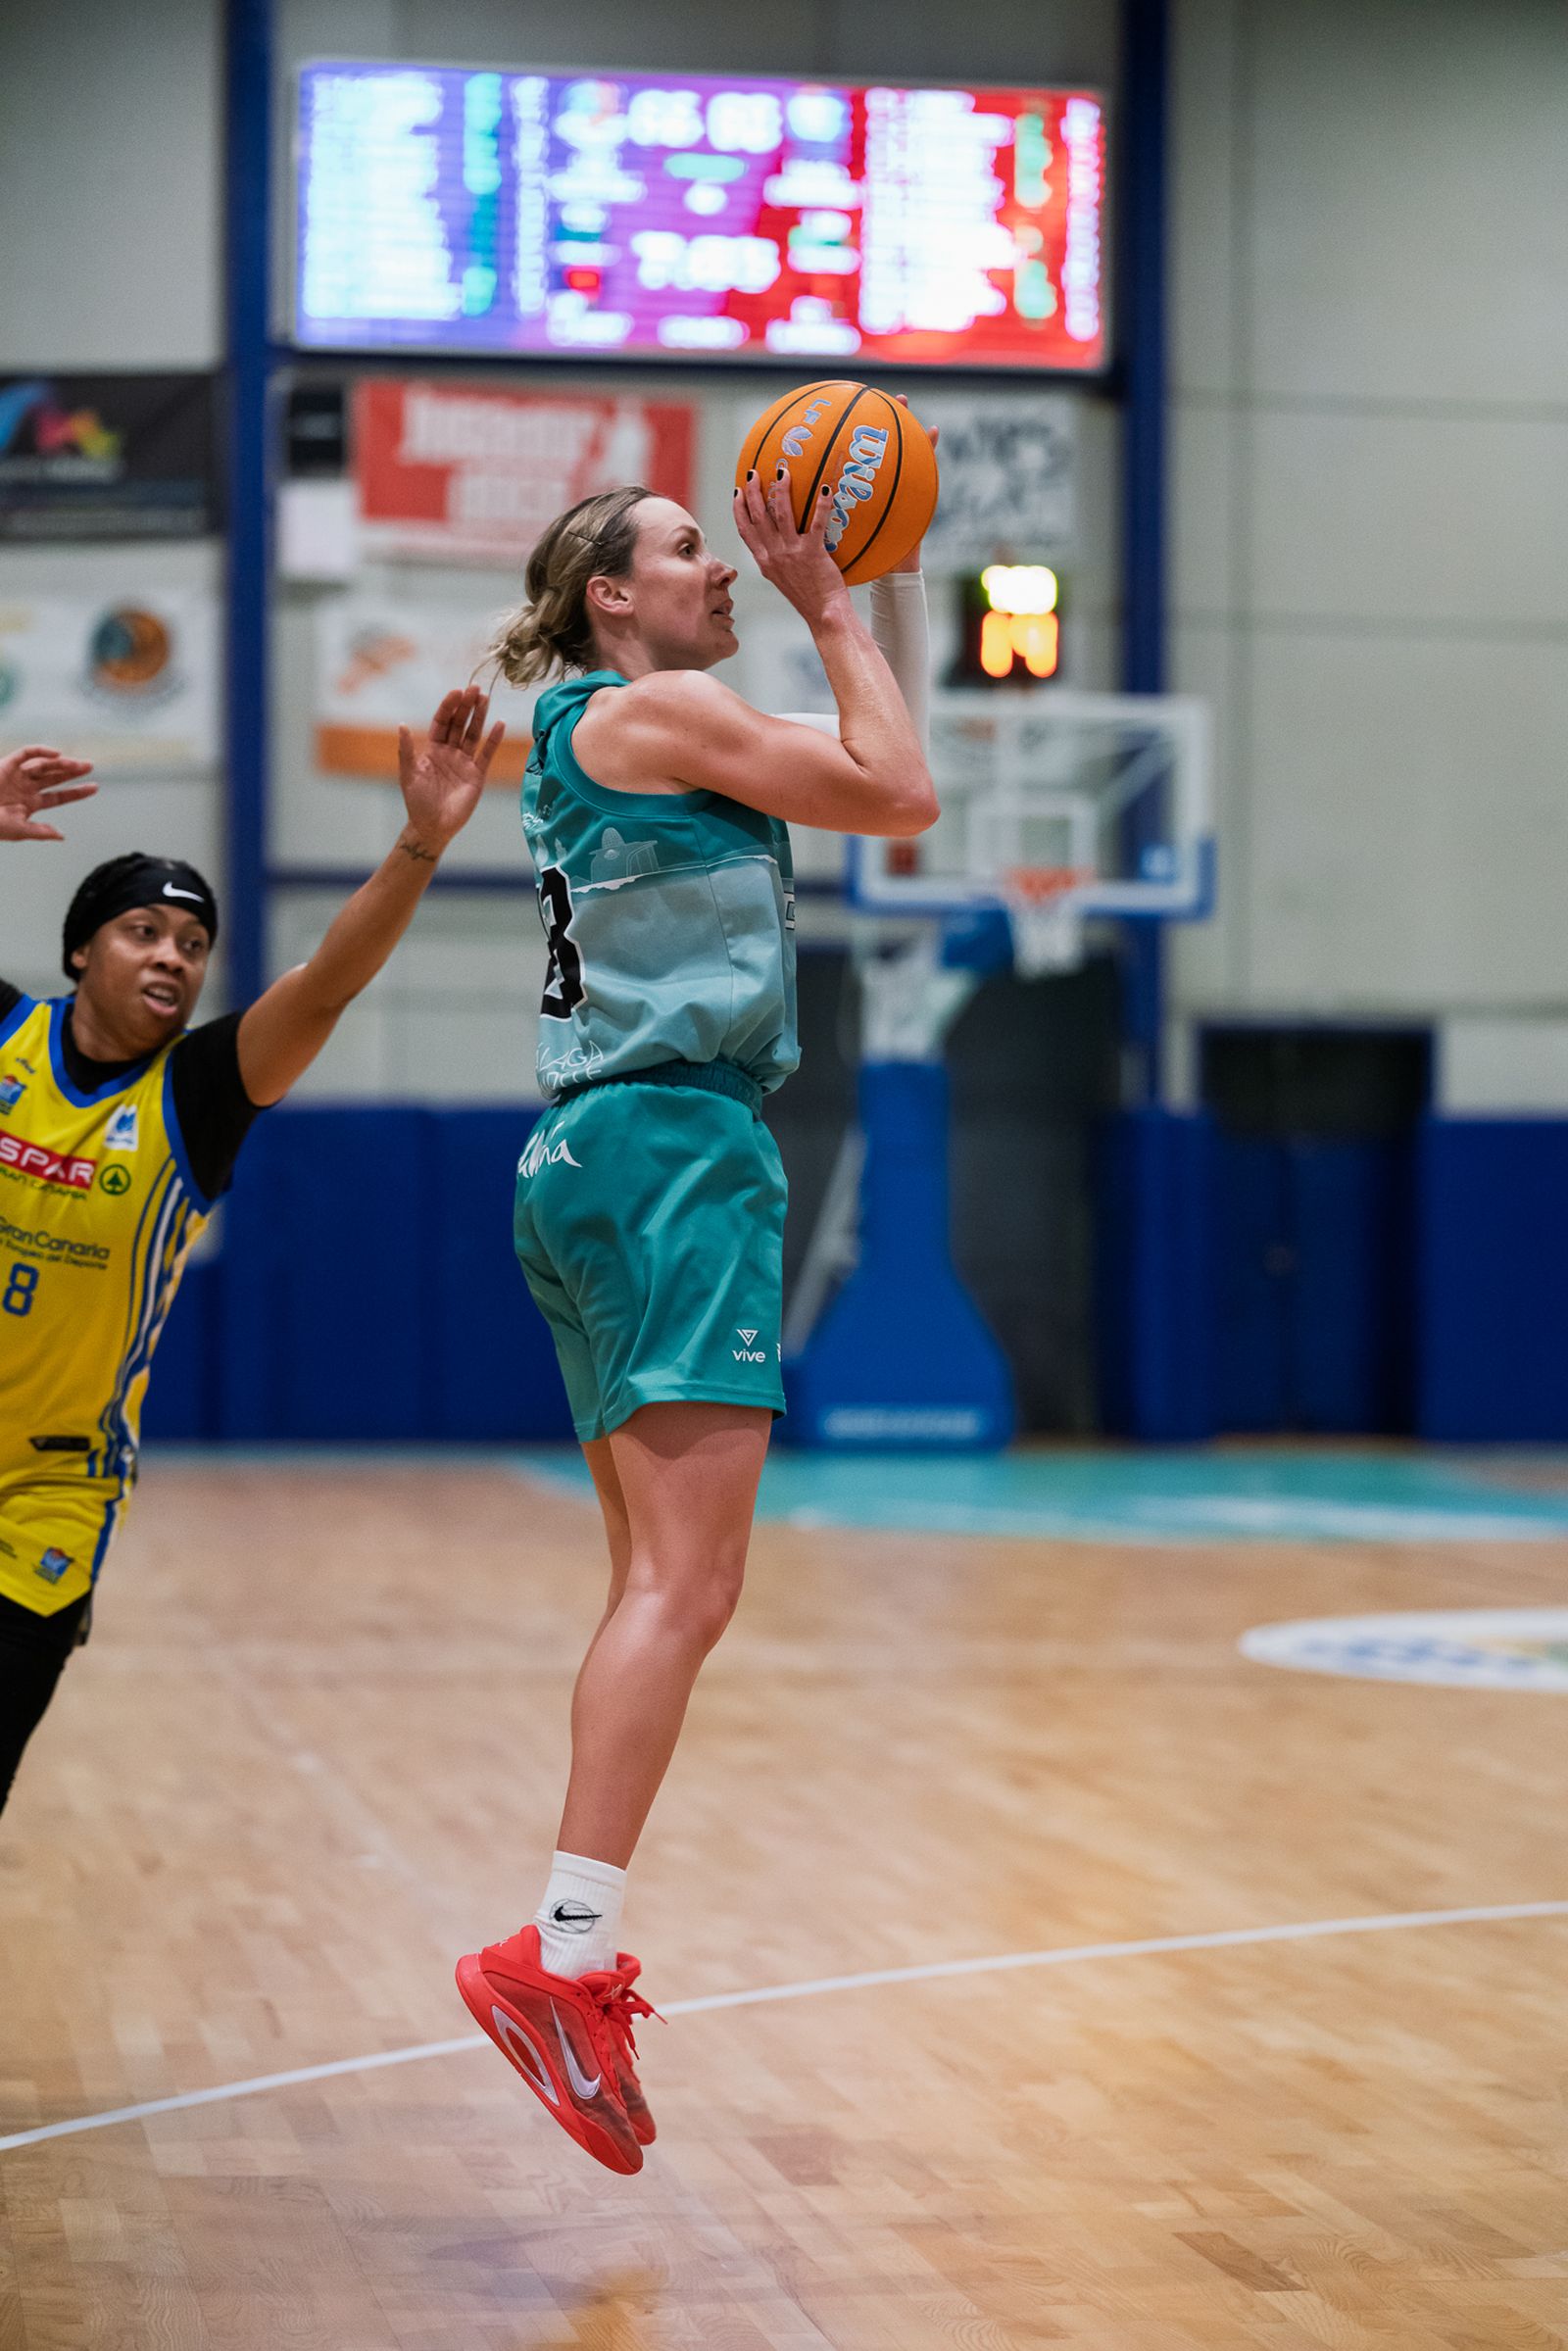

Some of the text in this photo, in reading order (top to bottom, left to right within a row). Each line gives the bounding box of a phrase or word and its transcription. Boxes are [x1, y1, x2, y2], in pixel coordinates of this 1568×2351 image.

[0, 1137, 95, 1184] SPAR
[3, 1261, 40, 1317] 8
[732, 1348, 765, 1363] vive
